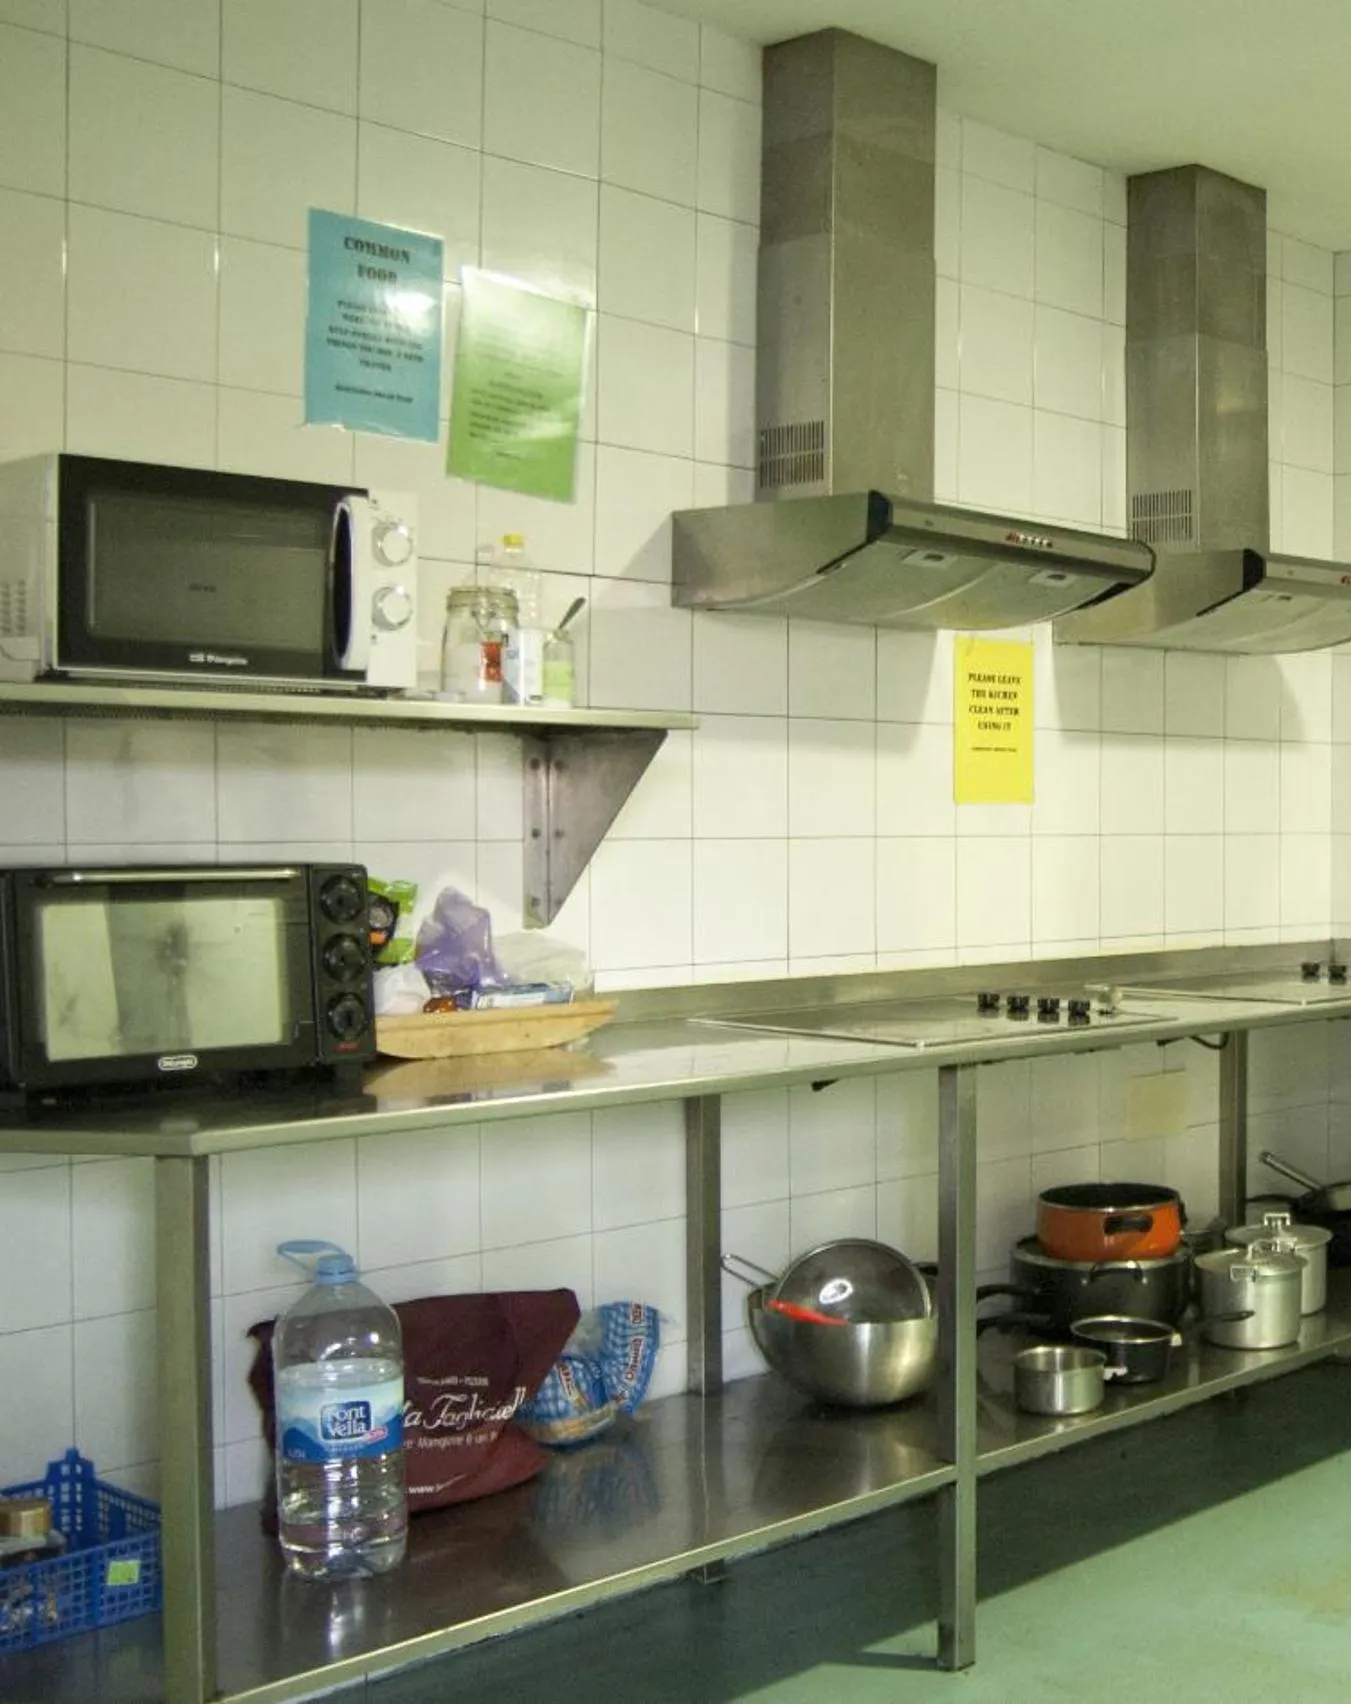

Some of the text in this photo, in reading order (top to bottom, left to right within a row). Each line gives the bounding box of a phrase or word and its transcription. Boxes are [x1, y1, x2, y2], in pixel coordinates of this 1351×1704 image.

[343, 235, 411, 265] COMMON
[357, 263, 398, 283] FOOD
[968, 672, 996, 685] PLEASE
[971, 689, 986, 699] THE
[968, 704, 1019, 716] CLEAN AFTER
[977, 721, 1001, 730] USING
